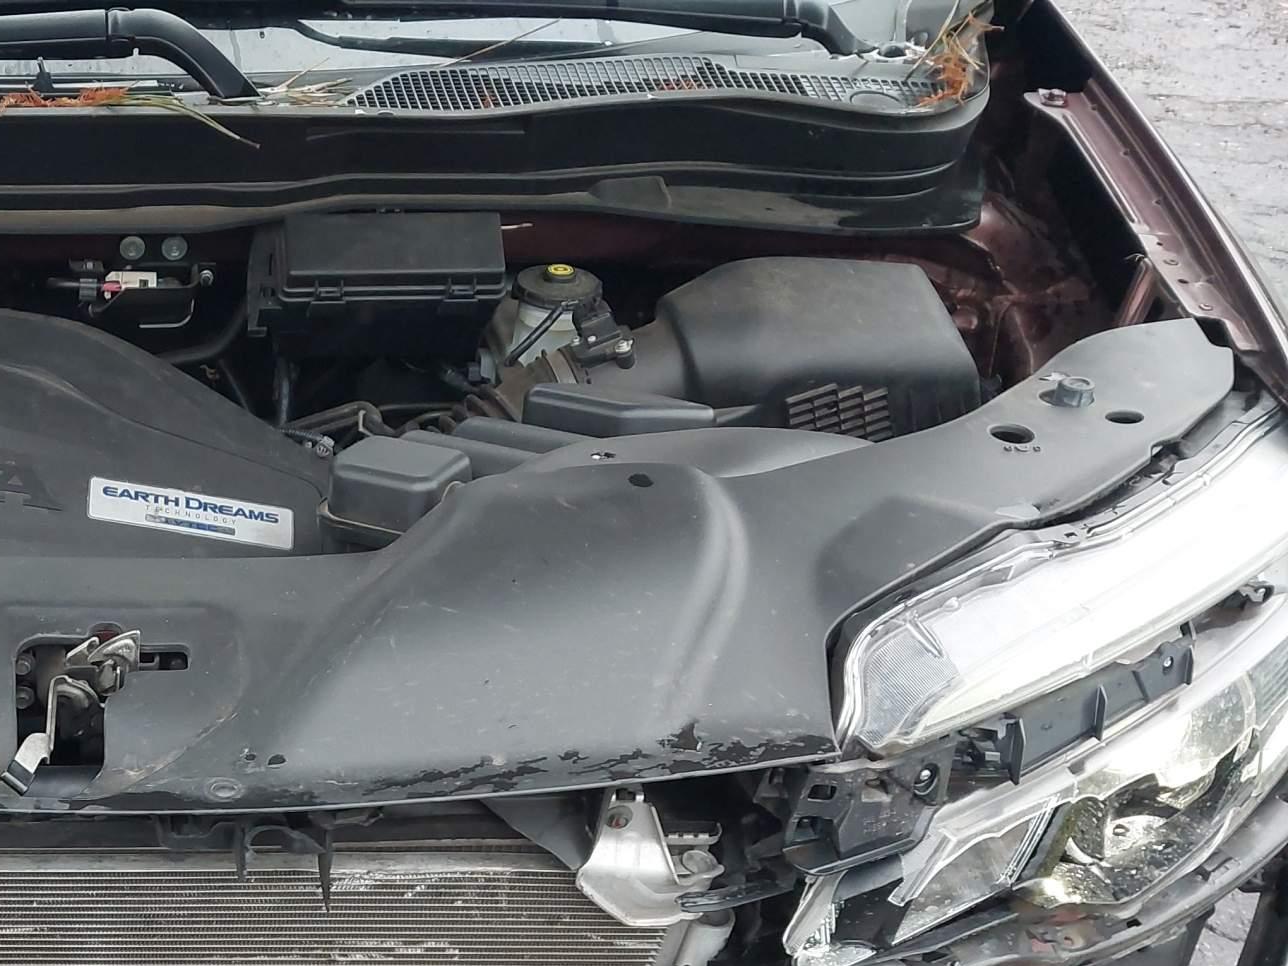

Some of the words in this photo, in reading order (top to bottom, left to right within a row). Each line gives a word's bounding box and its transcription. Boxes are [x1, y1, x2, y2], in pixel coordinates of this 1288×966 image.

[102, 485, 180, 508] EARTH
[184, 496, 280, 524] DREAMS
[145, 505, 237, 525] TECHNOLOGY
